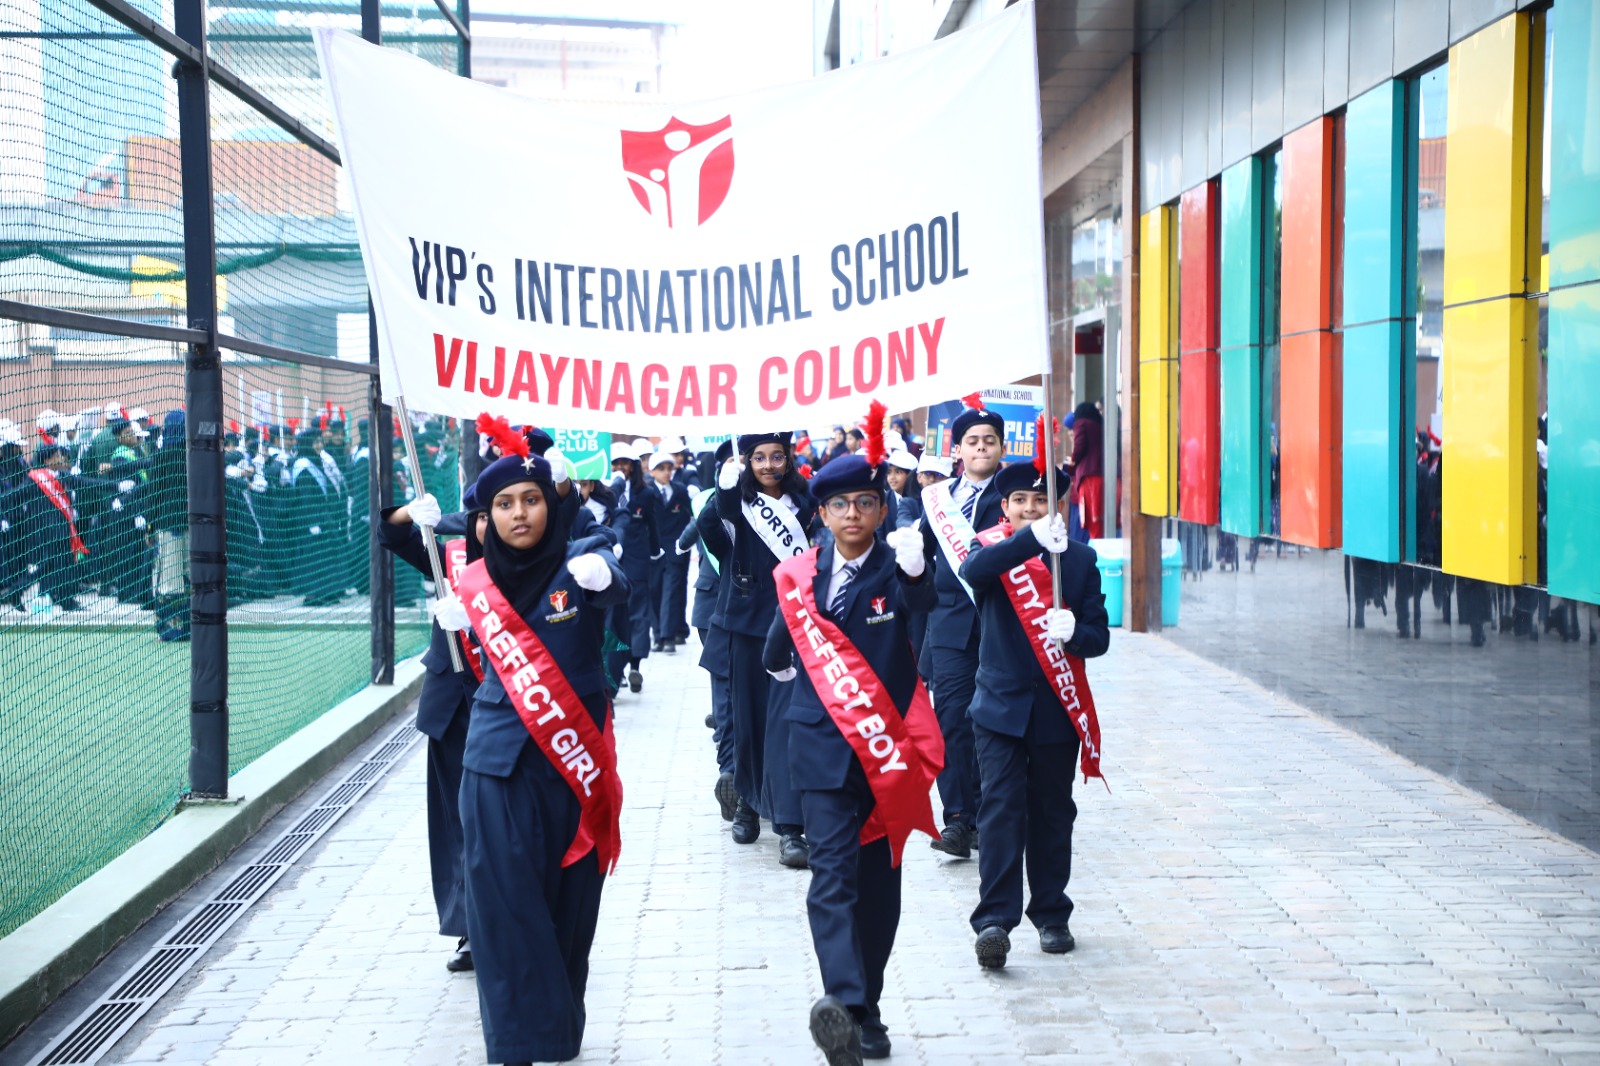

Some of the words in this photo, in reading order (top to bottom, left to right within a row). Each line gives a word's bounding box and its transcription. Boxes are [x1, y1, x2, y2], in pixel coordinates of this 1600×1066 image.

[409, 236, 496, 316] VIP's
[514, 253, 812, 334] INTERNATIONAL
[830, 211, 969, 312] SCHOOL
[432, 331, 739, 417] VIJAYNAGAR
[757, 316, 947, 412] COLONY
[1013, 390, 1033, 401] SCHOOL
[554, 439, 599, 452] CLUB
[555, 428, 599, 440] ECO
[1004, 441, 1034, 457] LUB
[471, 591, 566, 727] PREFECT
[550, 727, 602, 798] GIRL
[855, 713, 908, 775] BOY
